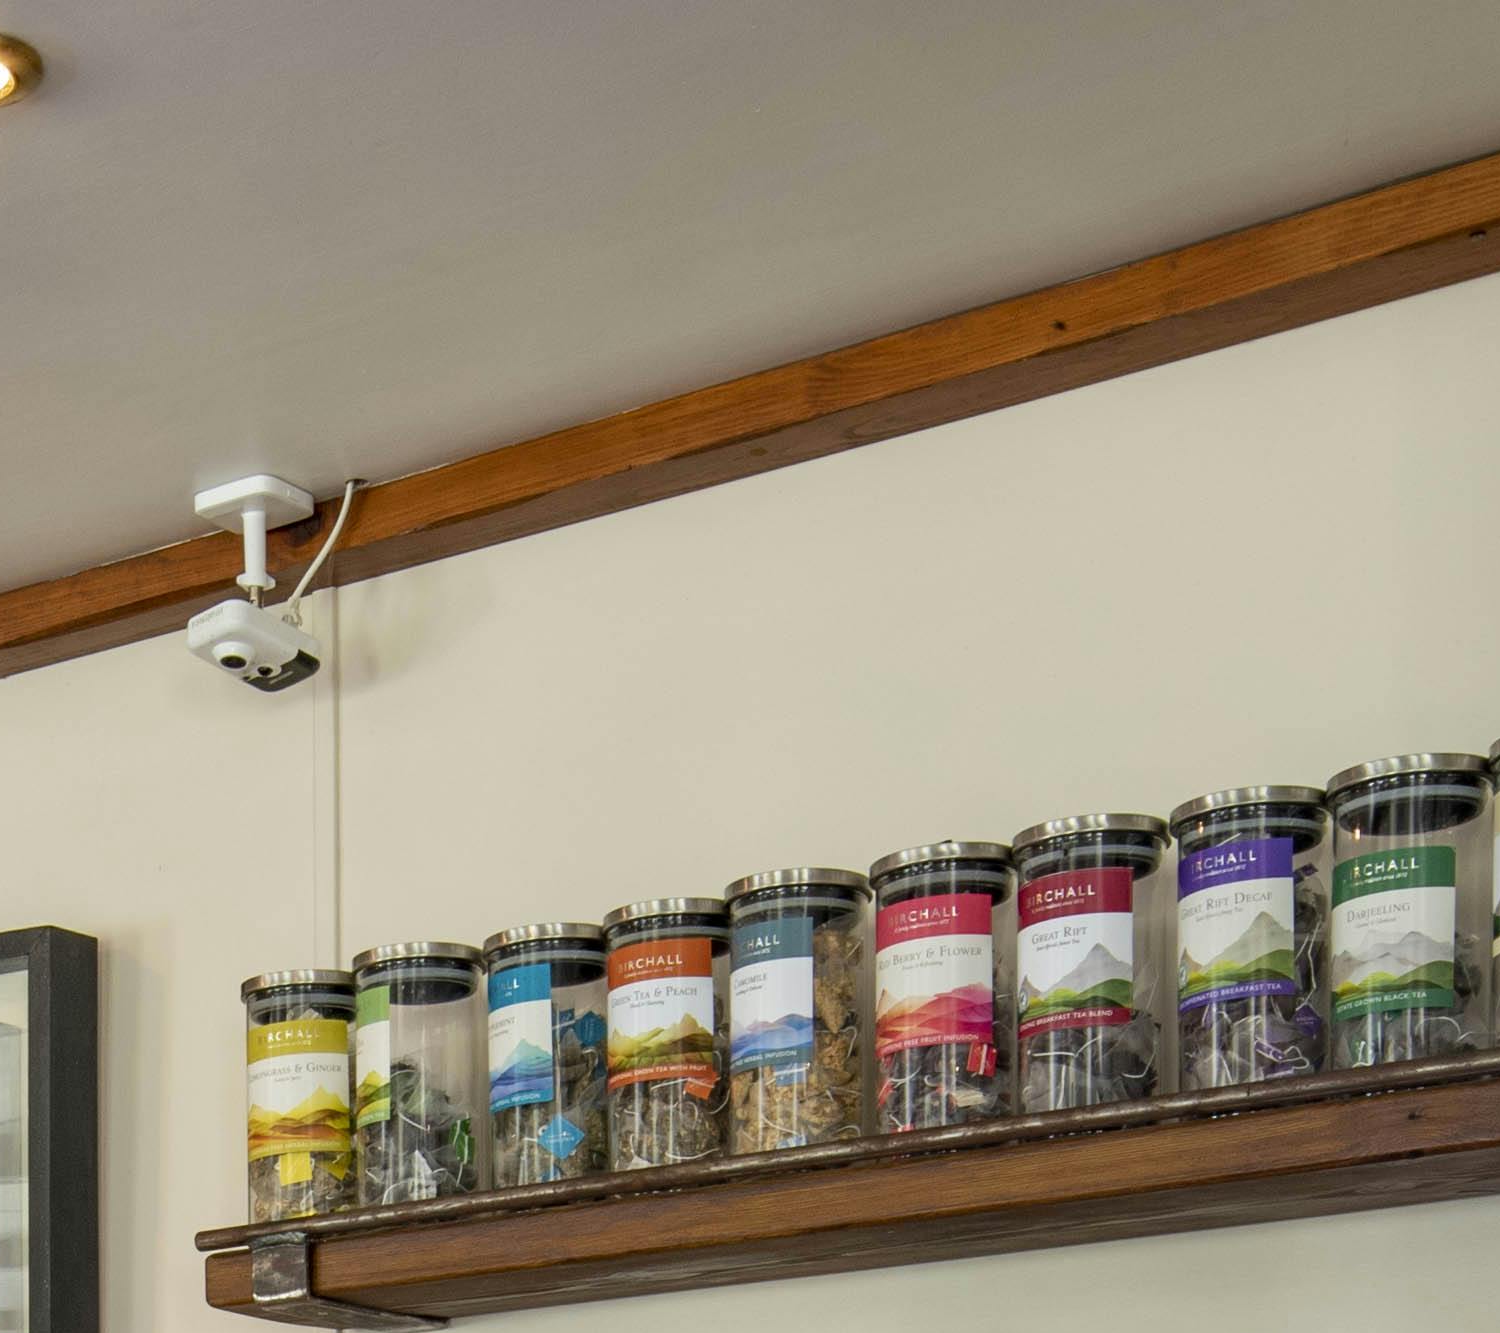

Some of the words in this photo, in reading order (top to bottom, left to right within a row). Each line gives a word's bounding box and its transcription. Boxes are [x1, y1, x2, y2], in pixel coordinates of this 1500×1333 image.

[1192, 849, 1257, 874] IRCHALL
[1206, 898, 1229, 911] RIFT
[1234, 892, 1272, 905] DECAF
[1347, 902, 1410, 922] DARJEELING
[1032, 930, 1060, 945] GREAT
[1064, 926, 1088, 938] RIFT
[893, 952, 921, 966] BERRY
[926, 949, 934, 958] &
[940, 945, 982, 956] FLOWER
[633, 990, 650, 1000] TEA
[654, 987, 662, 997] &
[666, 986, 698, 997] PEACH
[1221, 984, 1265, 997] BREAKFAST
[1383, 993, 1409, 1001] BLACK
[1089, 1009, 1113, 1017] BLEND
[306, 1062, 343, 1072] GINGER
